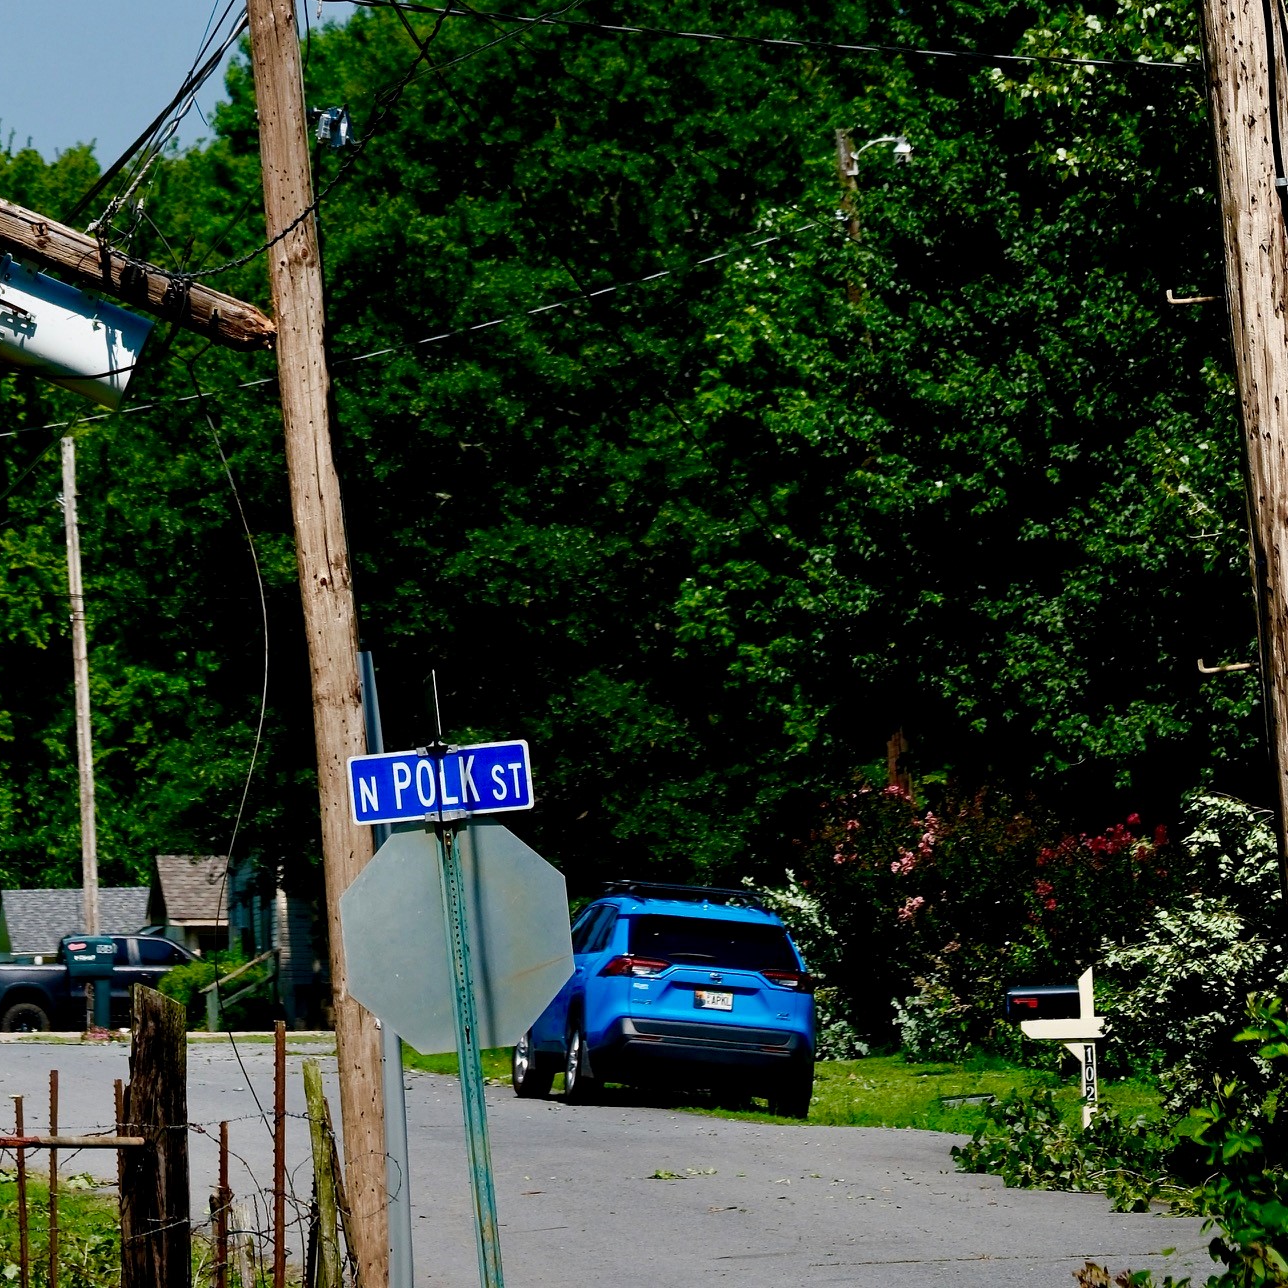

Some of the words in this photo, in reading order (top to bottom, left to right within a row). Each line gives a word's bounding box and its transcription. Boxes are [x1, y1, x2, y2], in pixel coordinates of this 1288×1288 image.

[359, 776, 379, 813] N
[392, 755, 481, 810] POLK
[491, 762, 522, 801] ST
[1085, 1046, 1096, 1102] 102
